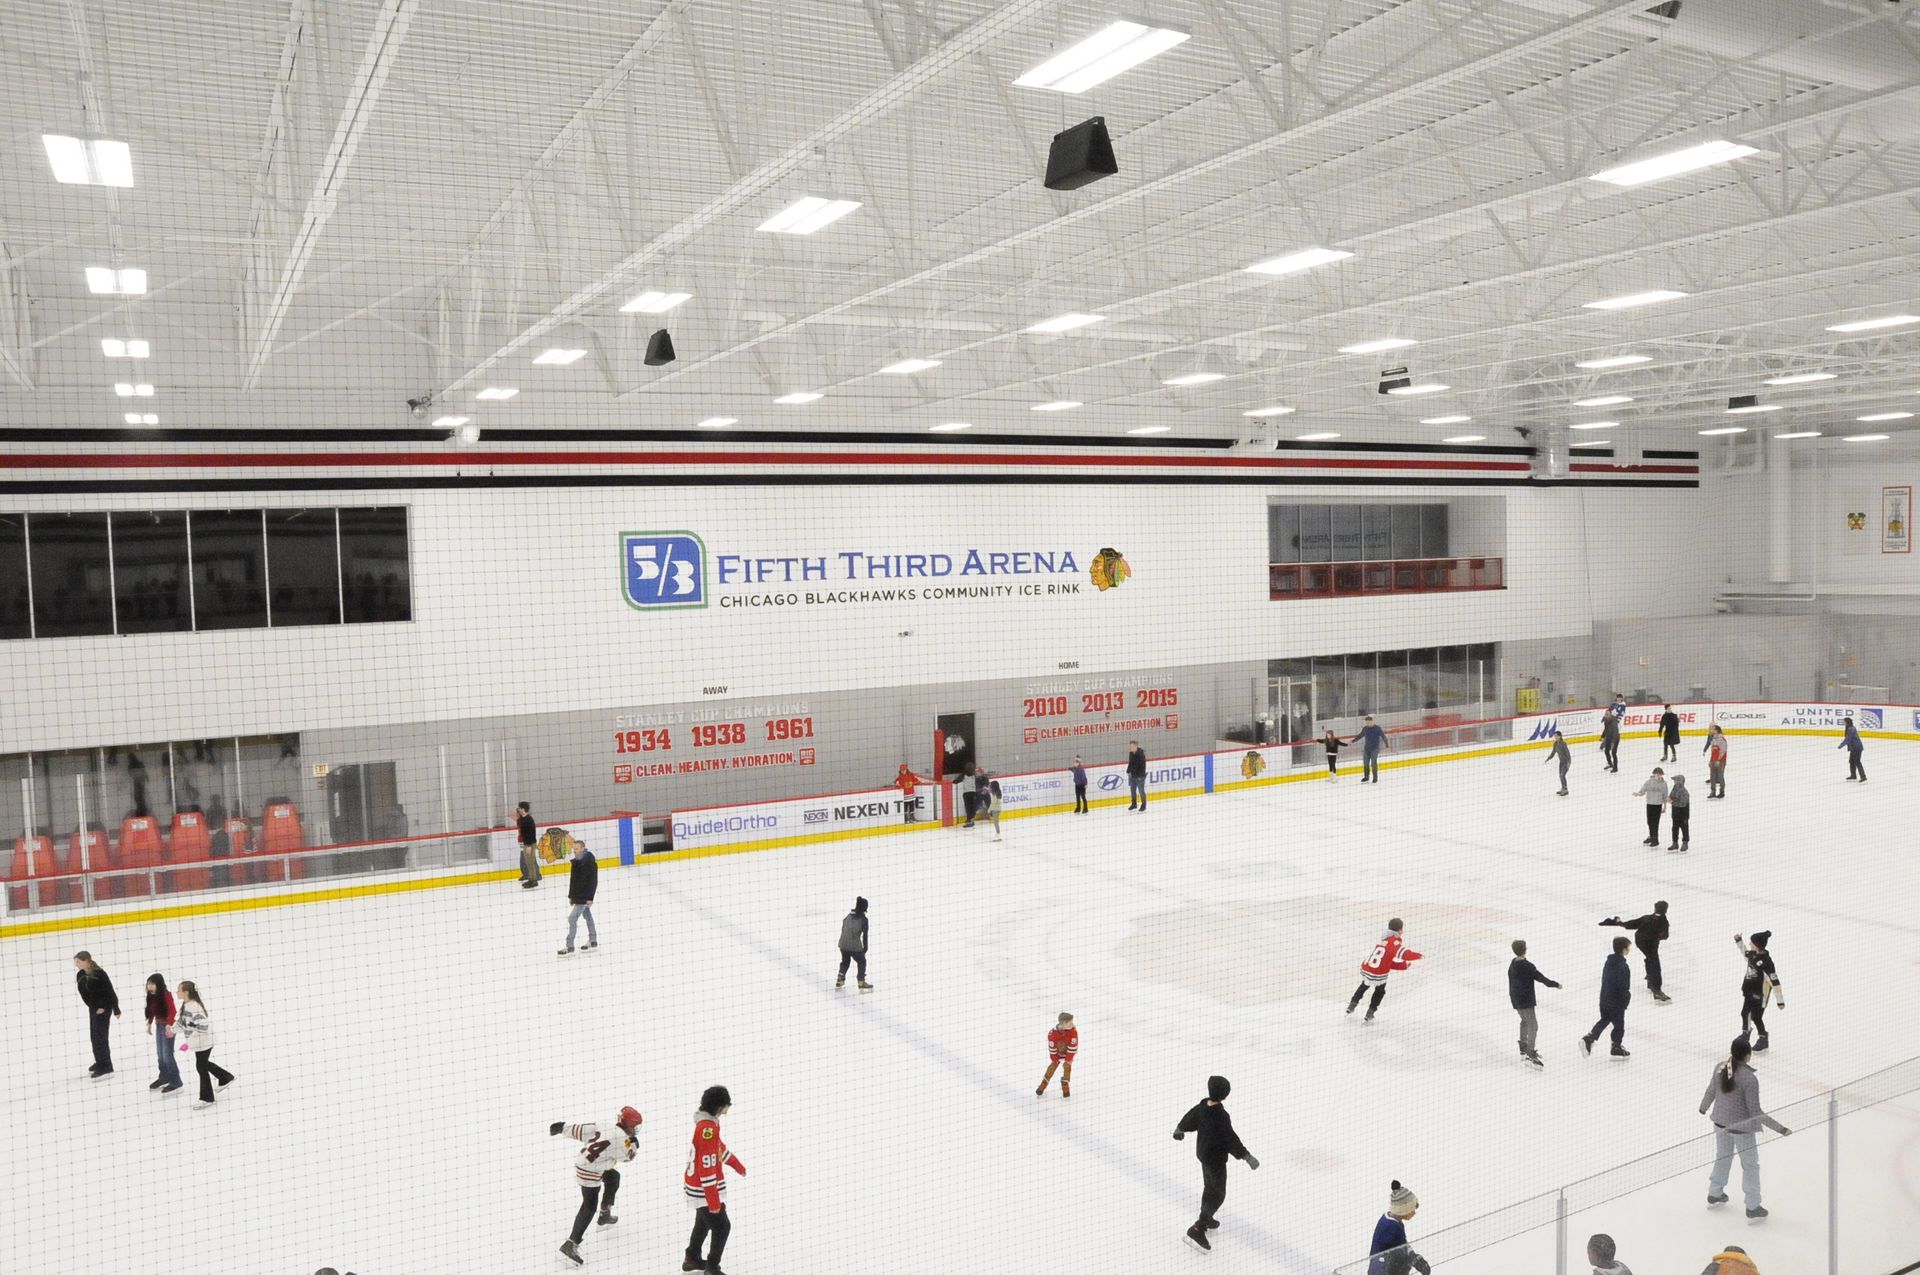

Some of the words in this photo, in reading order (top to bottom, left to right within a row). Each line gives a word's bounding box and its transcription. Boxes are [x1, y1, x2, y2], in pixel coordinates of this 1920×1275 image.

[716, 553, 827, 585] FIFTH
[838, 550, 954, 581] THIRD
[959, 548, 1080, 577] ARENA
[720, 593, 799, 608] CHICAGO
[805, 588, 917, 605] BLACKHAWKS
[922, 584, 1014, 600] COMMUNITY
[1018, 583, 1042, 597] ICE
[1047, 582, 1081, 596] RINK
[1058, 661, 1080, 670] HOME
[702, 685, 729, 696] AWAY
[1026, 680, 1080, 696] STANLEY
[1084, 678, 1106, 692] CUP
[1109, 673, 1174, 689] CHAMPIONS
[1023, 696, 1068, 718] 2010
[1082, 691, 1124, 713] 2013
[1136, 688, 1178, 708] 2015
[1795, 708, 1855, 717] UNITED
[615, 711, 685, 729] STANLEY
[690, 708, 719, 723] CUP
[724, 700, 809, 720] CHAMPIONS
[1623, 713, 1662, 726] BELLE
[1729, 712, 1767, 720] LEXUS
[1781, 717, 1847, 726] AIRLINE
[614, 728, 672, 754] 1934
[691, 722, 747, 748] 1938
[765, 716, 815, 742] 1961
[636, 763, 677, 778] CLEAN.
[678, 758, 730, 774] HEALTHY.
[732, 752, 797, 769] HYDRATION.
[1142, 766, 1197, 784] UNDAI
[1032, 780, 1061, 791] THIRD
[834, 801, 890, 821] NEXEN
[893, 796, 926, 814] TE
[673, 814, 778, 840] QuidelOrtho
[701, 1152, 718, 1169] 98
